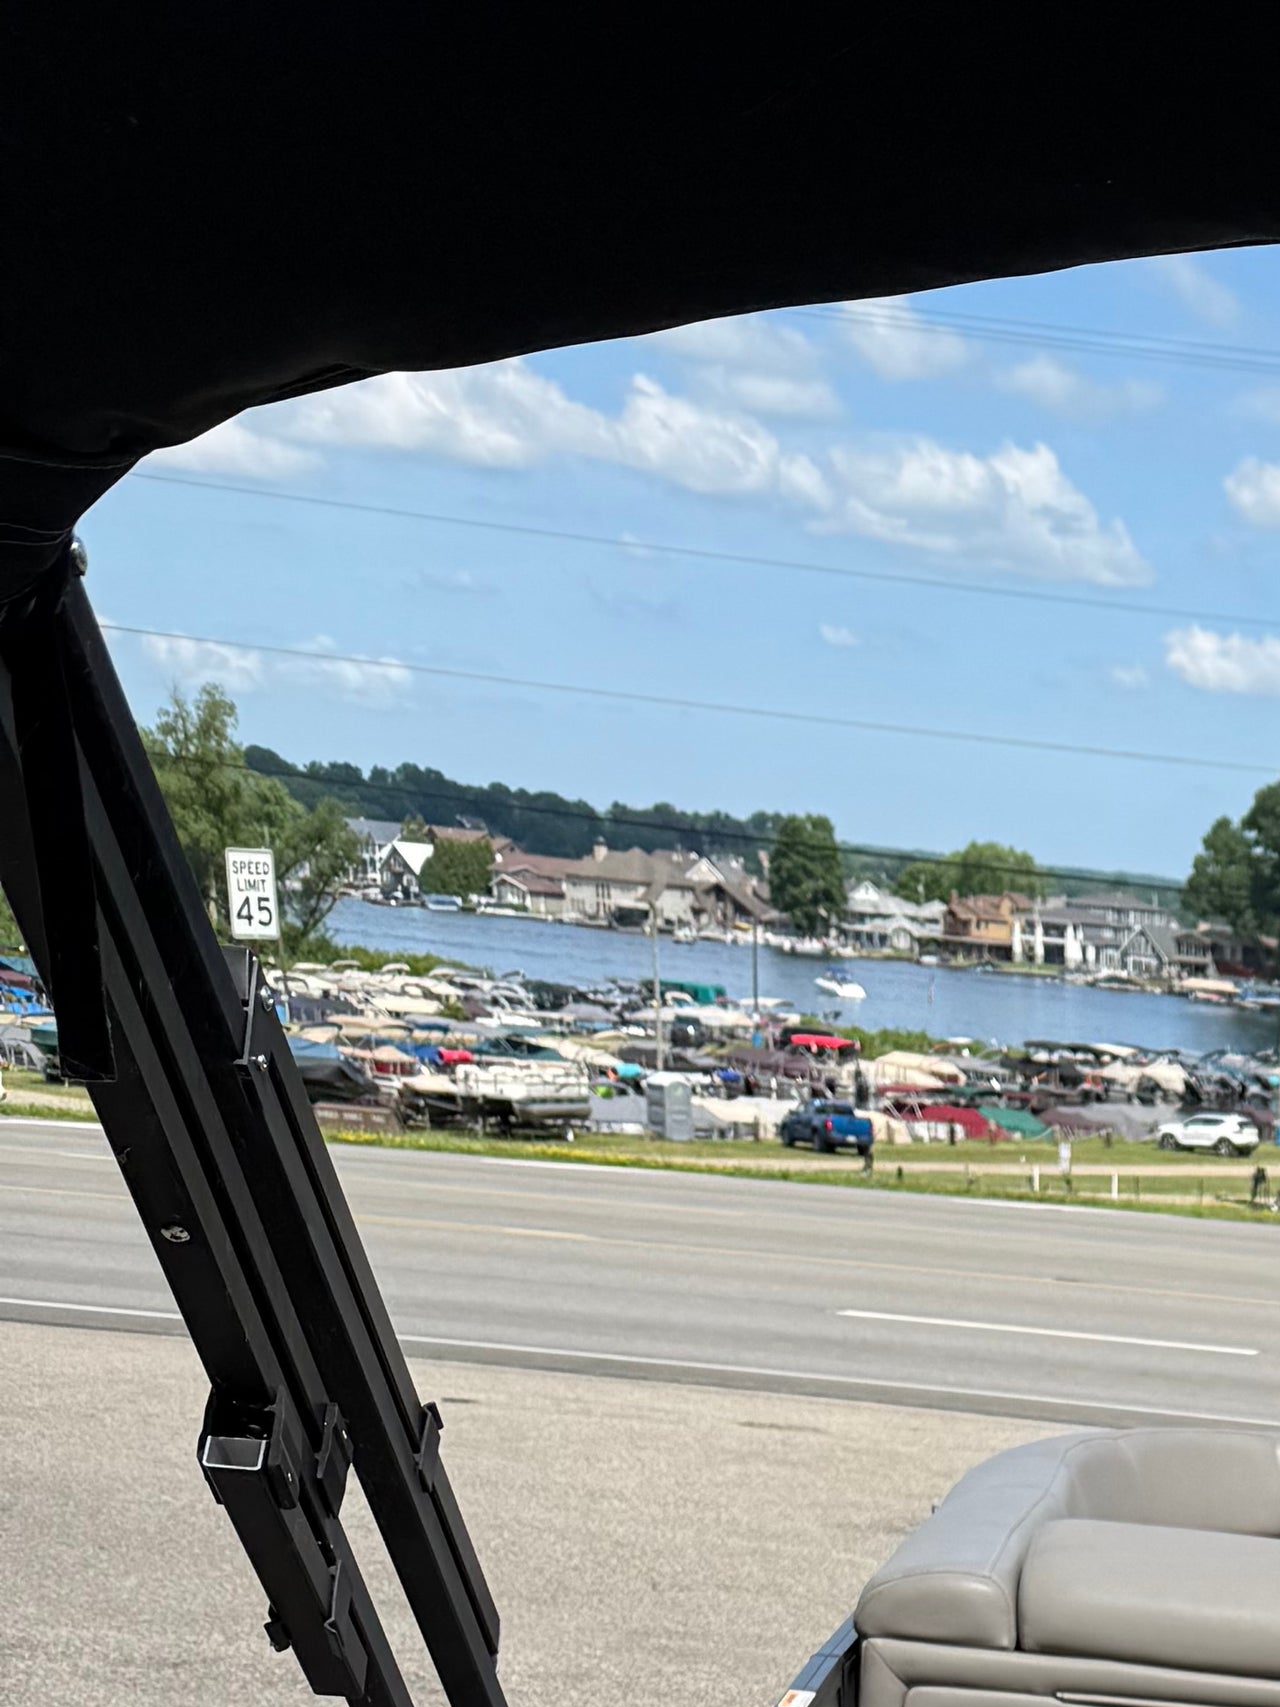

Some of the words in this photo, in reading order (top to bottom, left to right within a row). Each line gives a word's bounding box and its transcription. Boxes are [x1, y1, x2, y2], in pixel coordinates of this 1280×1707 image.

[232, 860, 270, 875] SPEED
[237, 878, 266, 893] LIMIT
[236, 895, 273, 927] 45
